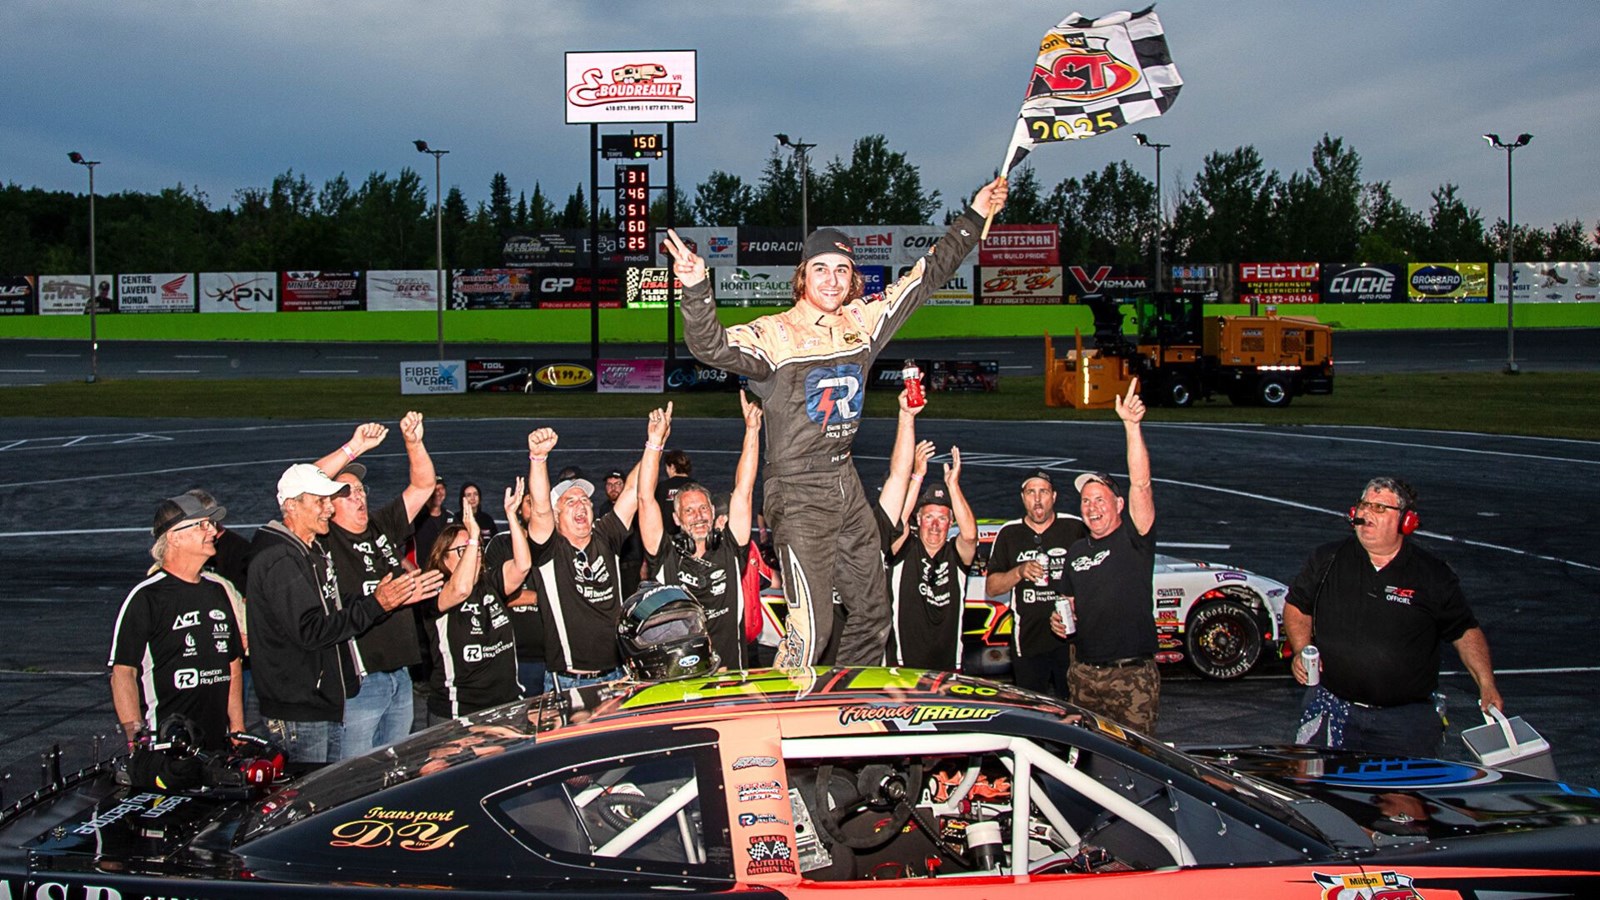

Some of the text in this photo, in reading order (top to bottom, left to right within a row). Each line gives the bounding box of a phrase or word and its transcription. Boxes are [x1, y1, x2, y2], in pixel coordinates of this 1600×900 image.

[1066, 36, 1085, 46] CAT
[634, 136, 656, 149] 150
[619, 171, 646, 183] 1 31
[619, 188, 646, 200] 2 46
[619, 204, 646, 216] 3 51
[619, 220, 646, 232] 4 60
[619, 237, 626, 249] 5
[628, 237, 646, 249] 25
[987, 235, 1051, 247] CRAFTSMAN
[624, 254, 649, 262] media
[1004, 252, 1024, 260] BUILD
[1172, 266, 1205, 278] Mobil
[1242, 265, 1316, 279] FECTO
[122, 275, 152, 284] CENTRE
[1411, 275, 1461, 285] BROSSARD
[122, 285, 156, 294] LAVERTU
[122, 296, 149, 304] HONDA
[405, 366, 439, 376] FIBRE
[698, 369, 728, 381] 103,5
[414, 376, 454, 386] VERRE
[1017, 550, 1038, 562] ACT
[1386, 594, 1411, 605] OFFICIEL
[1197, 604, 1239, 624] Hoosier
[172, 610, 201, 630] ACT
[213, 623, 229, 632] ASP
[200, 669, 222, 677] Gestion
[200, 677, 213, 685] Roy
[950, 684, 998, 696] QC
[909, 704, 1001, 725] TARDIF
[364, 806, 455, 823] Transport
[751, 835, 786, 844] GARAGE
[749, 860, 794, 868] AUTOTECH
[747, 866, 780, 875] MORIN
[1349, 876, 1378, 886] Milton
[1384, 875, 1395, 883] CAT
